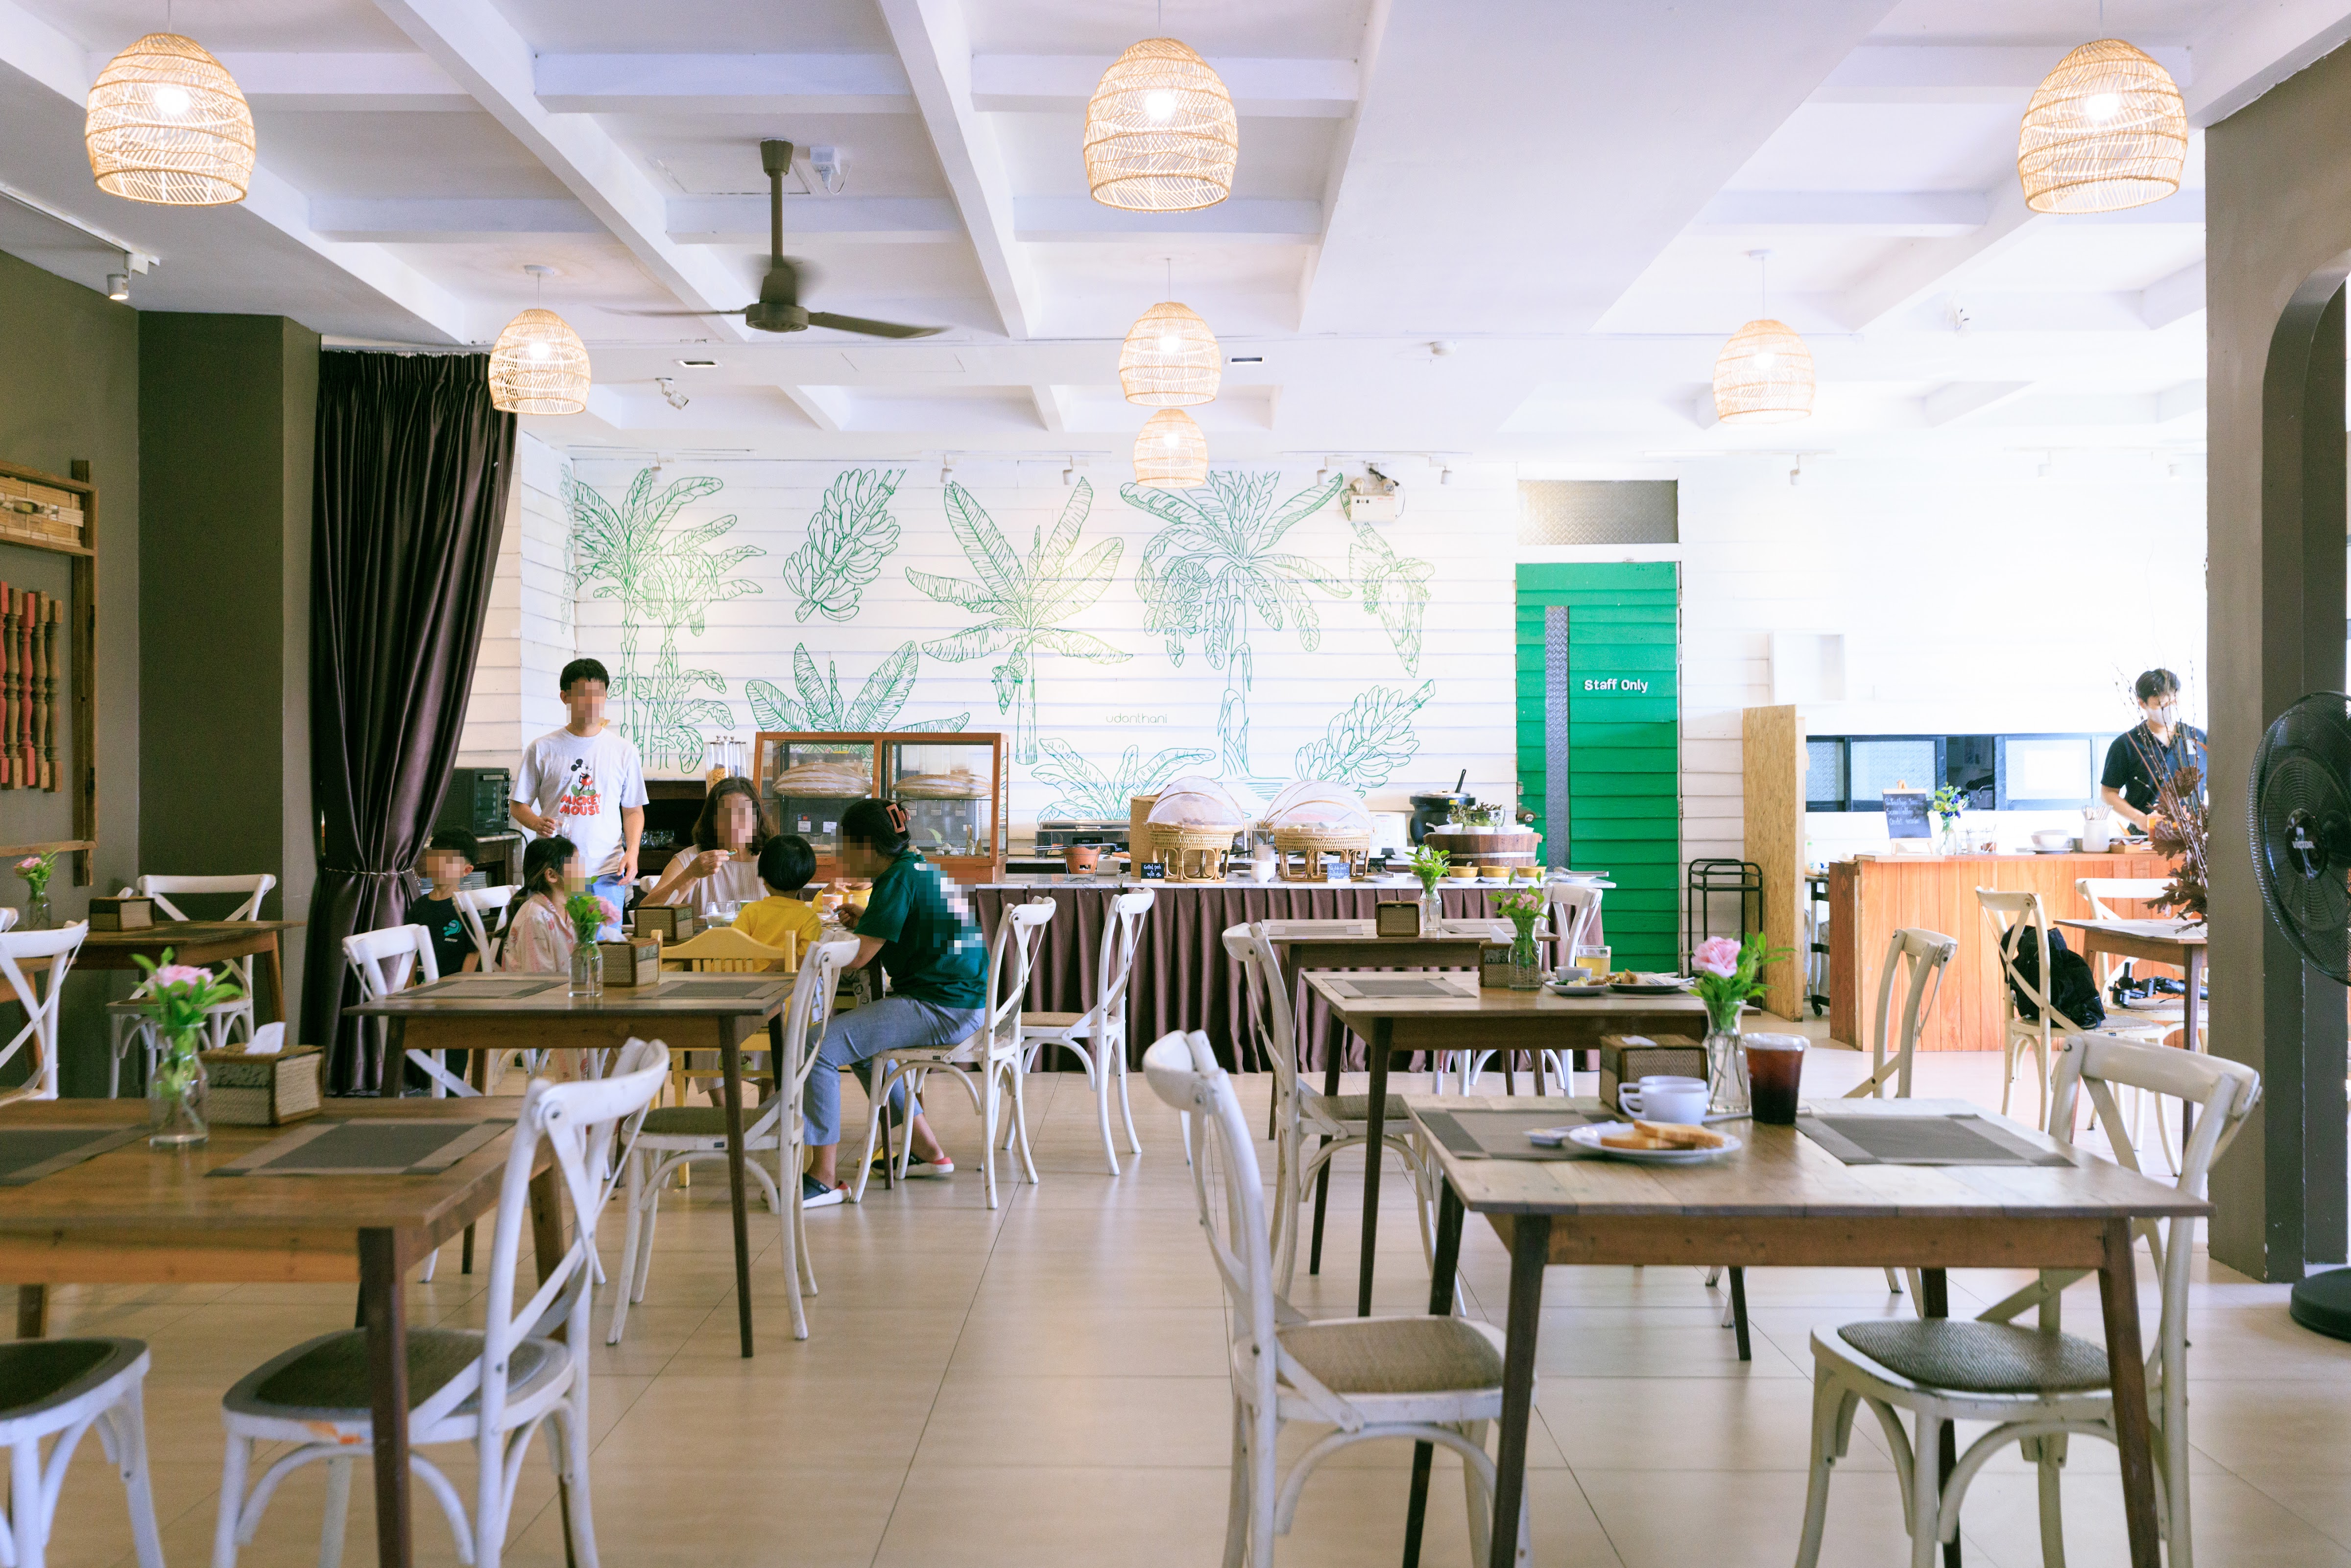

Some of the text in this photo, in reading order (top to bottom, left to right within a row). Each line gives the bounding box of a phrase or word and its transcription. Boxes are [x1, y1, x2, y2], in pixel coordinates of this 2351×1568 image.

[1584, 679, 1649, 694] Staff Only
[560, 793, 601, 806] MICKEY
[559, 805, 600, 815] MOUSE
